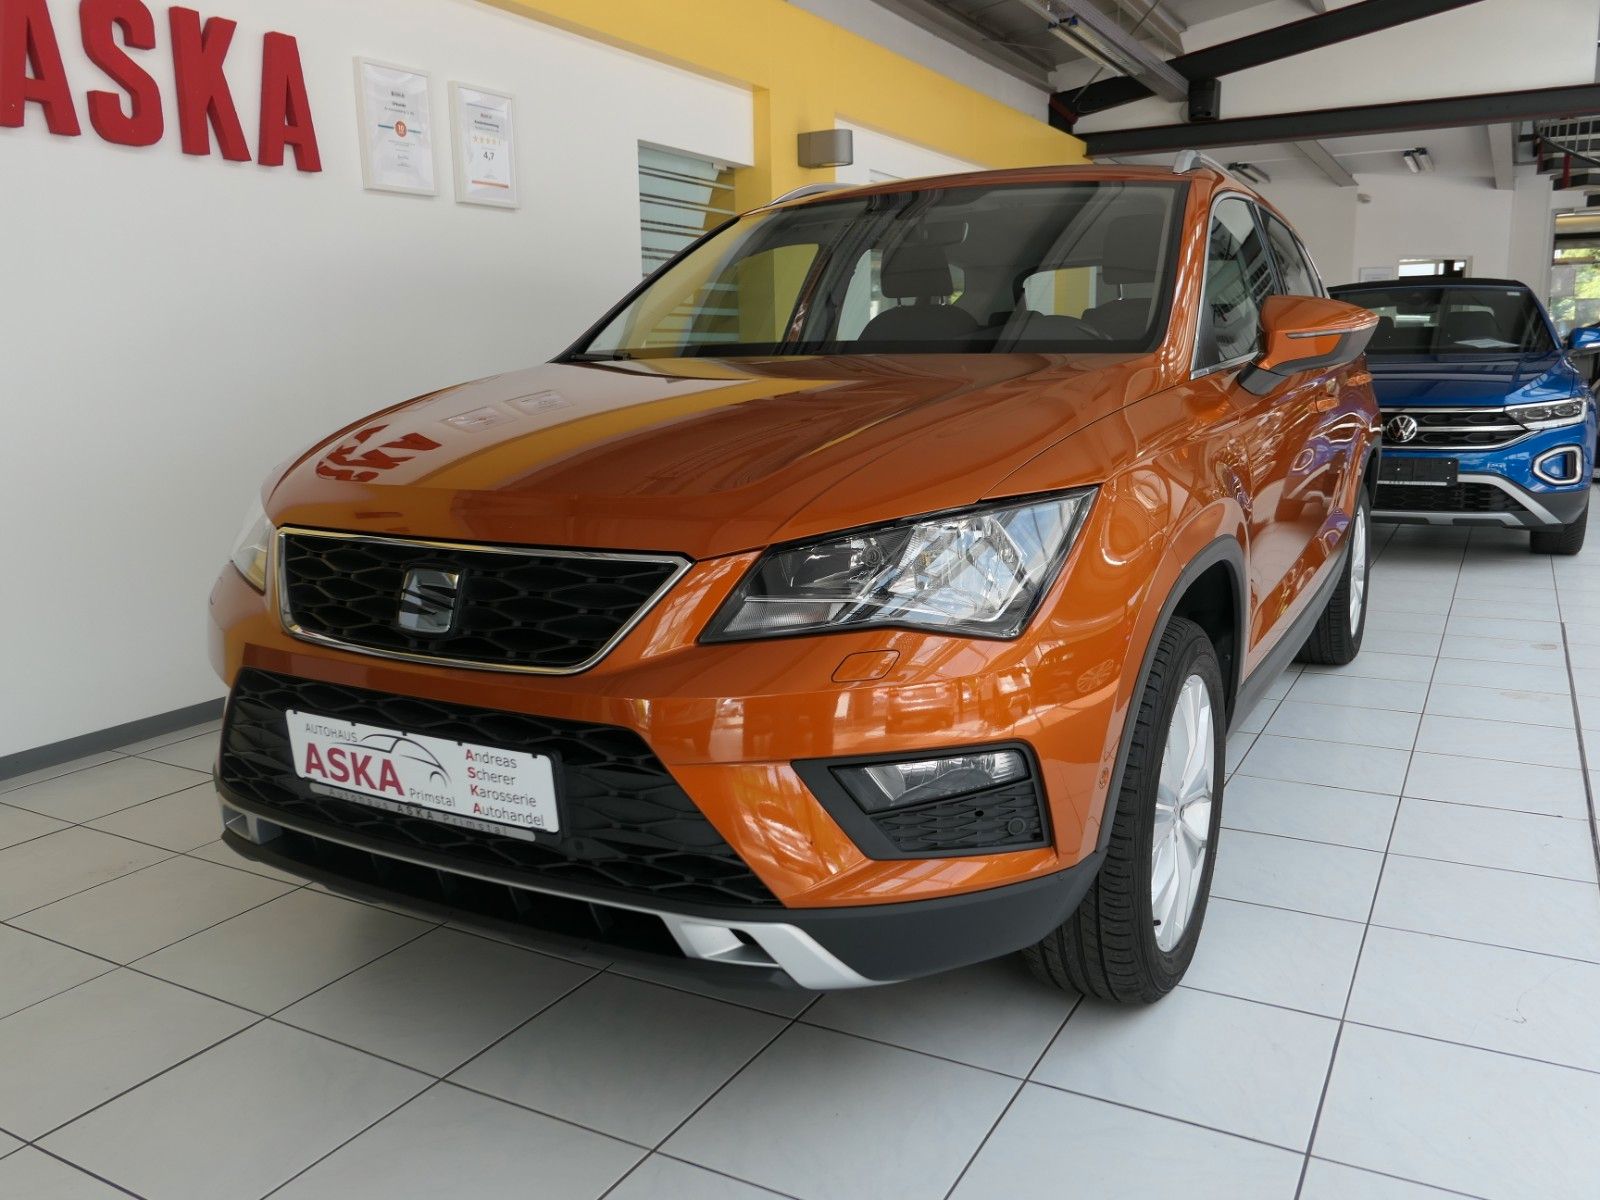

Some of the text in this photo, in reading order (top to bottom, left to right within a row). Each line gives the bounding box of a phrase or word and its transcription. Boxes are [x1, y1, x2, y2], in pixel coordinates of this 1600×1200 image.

[0, 0, 322, 172] ASKA
[483, 151, 494, 160] 4,7
[306, 723, 358, 742] AUTOHAUS
[465, 749, 518, 769] Andreas
[305, 742, 456, 807] ASKA Primstal
[467, 766, 516, 786] Scherer
[470, 784, 537, 808] Karosserie
[397, 804, 434, 820] ASKA
[443, 814, 509, 835] Primstal
[473, 803, 545, 827] Autohandel
